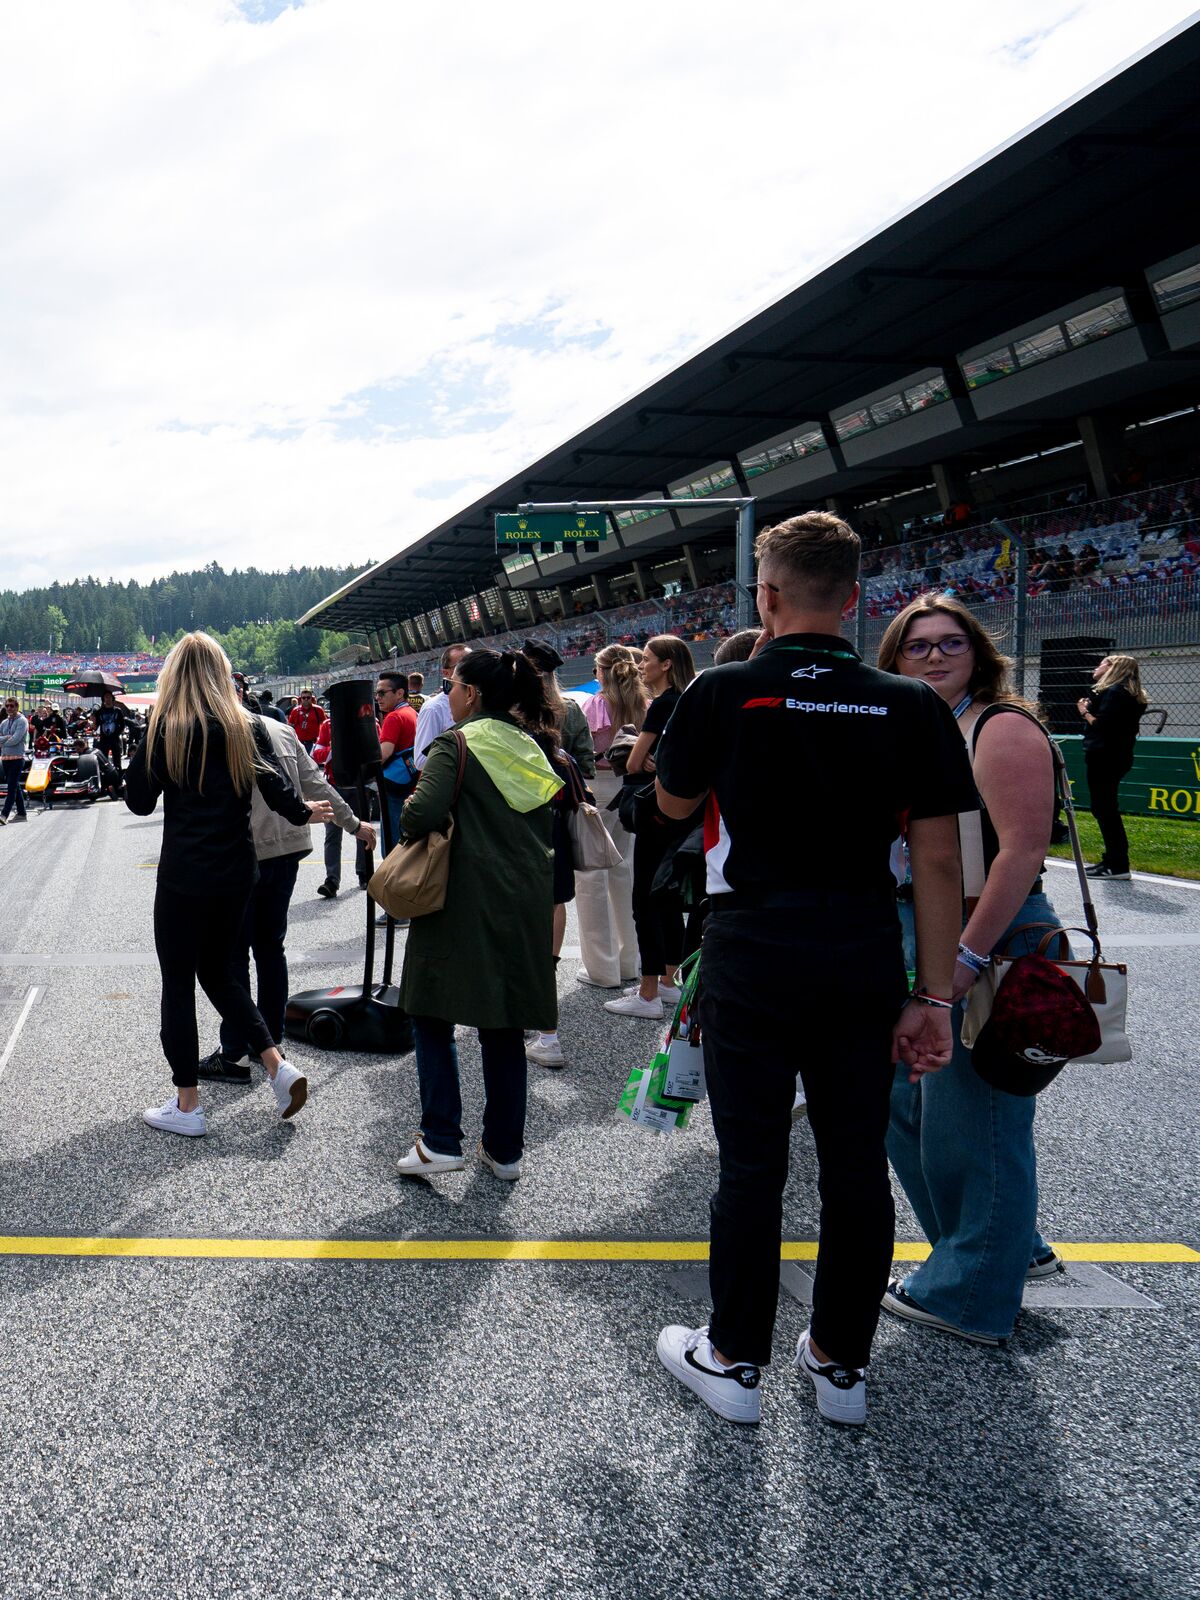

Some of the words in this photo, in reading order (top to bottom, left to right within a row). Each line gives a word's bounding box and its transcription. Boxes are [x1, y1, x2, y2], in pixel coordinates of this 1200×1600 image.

[505, 531, 541, 539] ROLEX
[563, 529, 600, 538] ROLEX
[785, 698, 888, 716] Experiences
